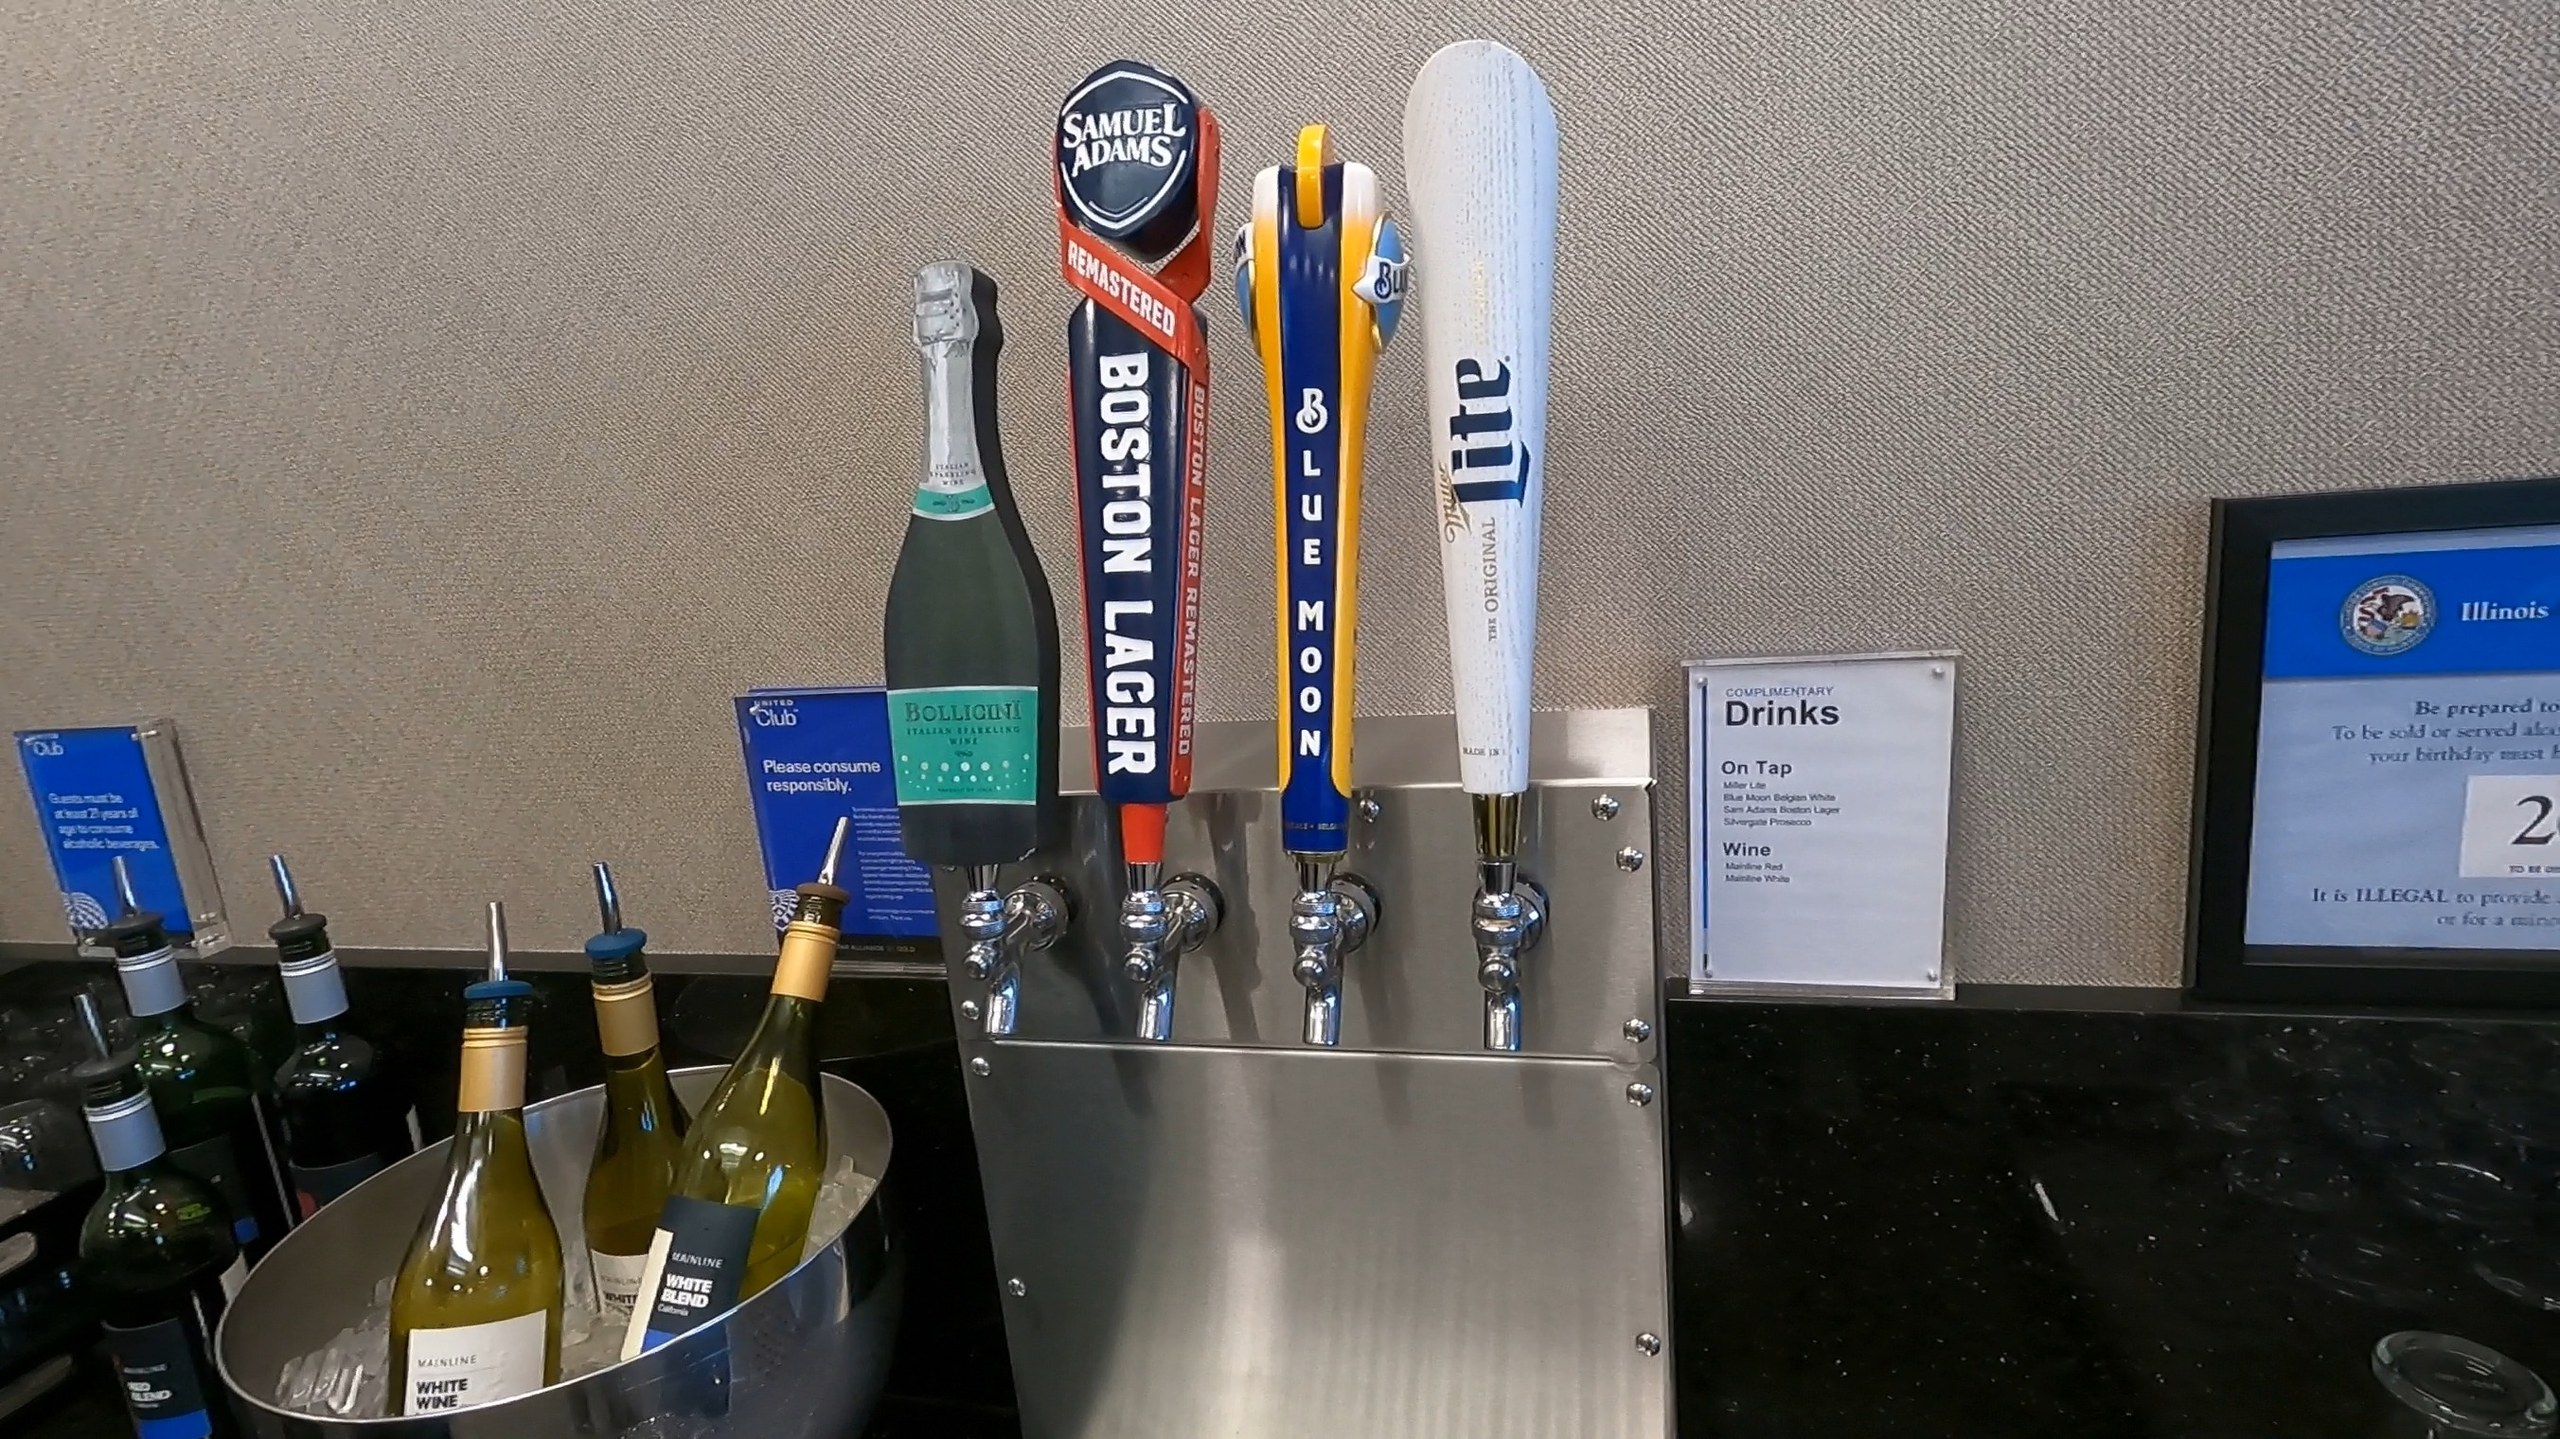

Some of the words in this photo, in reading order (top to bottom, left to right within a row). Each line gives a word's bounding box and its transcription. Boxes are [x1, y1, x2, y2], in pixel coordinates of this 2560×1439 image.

[1063, 103, 1187, 149] SAMUEL
[1071, 135, 1172, 178] ADAMS
[1067, 239, 1177, 337] REMASTERED
[1374, 262, 1408, 300] BLU
[1190, 386, 1206, 487] BOSTON
[1450, 357, 1531, 508] Lite
[1099, 352, 1152, 574] BOSTON
[1295, 387, 1328, 565] BLUE
[1187, 497, 1202, 577] LAGER
[1482, 516, 1500, 613] ORIGINAL
[2461, 601, 2549, 621] Illinois
[1488, 617, 1498, 642] THE
[1178, 587, 1200, 756] REMASTERED
[1298, 600, 1325, 757] MOON
[1104, 599, 1157, 775] LAGER
[1725, 686, 1834, 698] COMPLIMENTARY
[754, 699, 794, 707] UNITED
[905, 700, 1022, 722] BOLLICINI
[2415, 701, 2440, 716] Be
[2447, 698, 2533, 718] prepared
[2540, 702, 2560, 714] to
[755, 708, 797, 727] Club
[1726, 699, 1841, 726] Drinks
[907, 727, 951, 736] ITALIAN
[957, 725, 1021, 735] SPARKLING
[2332, 725, 2355, 740] To
[2362, 724, 2383, 740] be
[2389, 724, 2425, 739] sold
[2431, 727, 2450, 739] or
[2456, 722, 2517, 738] served
[33, 741, 64, 756] Club
[949, 737, 978, 745] WINE
[2368, 750, 2410, 765] your
[2415, 747, 2494, 764] birthday
[763, 759, 811, 774] Please
[813, 761, 881, 774] consume
[1721, 760, 1749, 775] On
[1756, 760, 1792, 778] Tap
[766, 778, 853, 795] responsibly.
[1723, 781, 1747, 789] Miller
[1723, 793, 1744, 801] Blue
[1773, 793, 1807, 803] Belgian
[1723, 805, 1744, 814] Sam
[1746, 806, 1777, 814] Adams
[1779, 806, 1811, 814] Boston
[1814, 806, 1841, 816] Lager
[1769, 818, 1812, 826] Prosecco
[2511, 795, 2560, 845] 2
[1723, 842, 1771, 856] Wine
[1725, 862, 1762, 870] Mainline
[1764, 862, 1783, 871] Red
[1764, 875, 1790, 883] White
[2313, 887, 2327, 902] It
[2334, 888, 2348, 902] is
[2356, 887, 2448, 904] ILLEGAL
[671, 1251, 724, 1269] MAINLINE
[666, 1273, 713, 1294] WHITE
[602, 1291, 640, 1306] WHIT
[660, 1287, 709, 1308] BLEND
[657, 1303, 690, 1317] California
[417, 1354, 478, 1368] MAINLINE
[416, 1378, 468, 1395] WHITE
[416, 1394, 458, 1410] WINE
